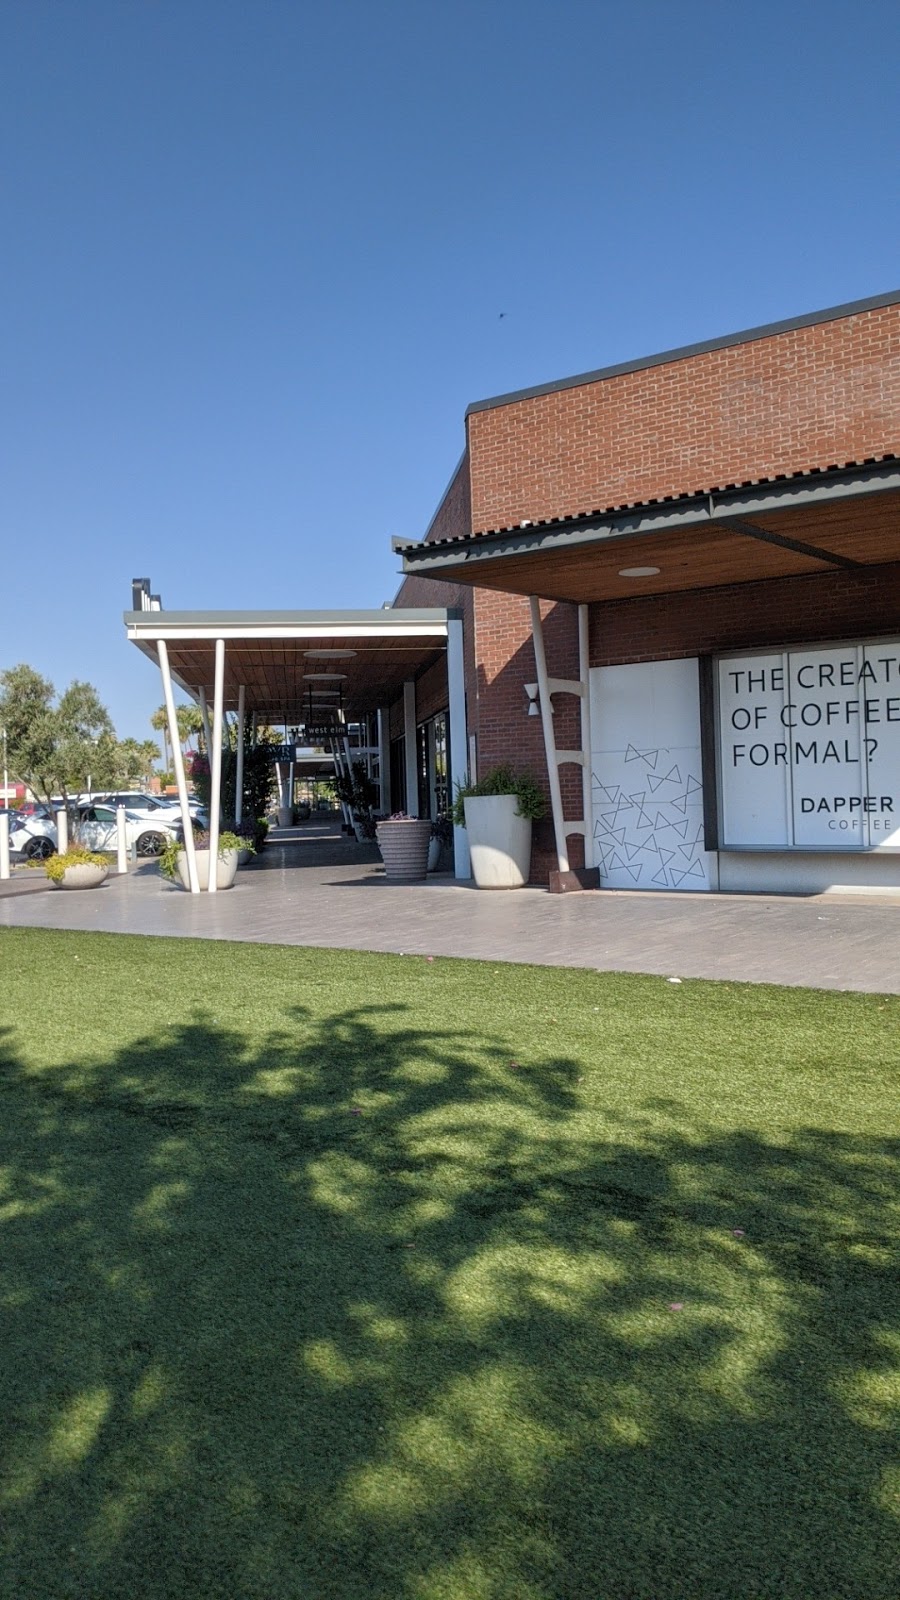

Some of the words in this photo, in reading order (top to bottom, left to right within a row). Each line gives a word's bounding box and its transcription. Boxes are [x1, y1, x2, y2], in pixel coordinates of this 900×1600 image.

[728, 667, 784, 694] THE
[797, 658, 900, 689] CREAT
[731, 706, 768, 731] OF
[780, 697, 900, 728] COFFEE
[308, 726, 328, 734] west
[330, 726, 345, 734] elm
[733, 738, 879, 767] FORMAL?
[801, 796, 894, 813] DAPPER
[828, 819, 892, 830] COFFEE
